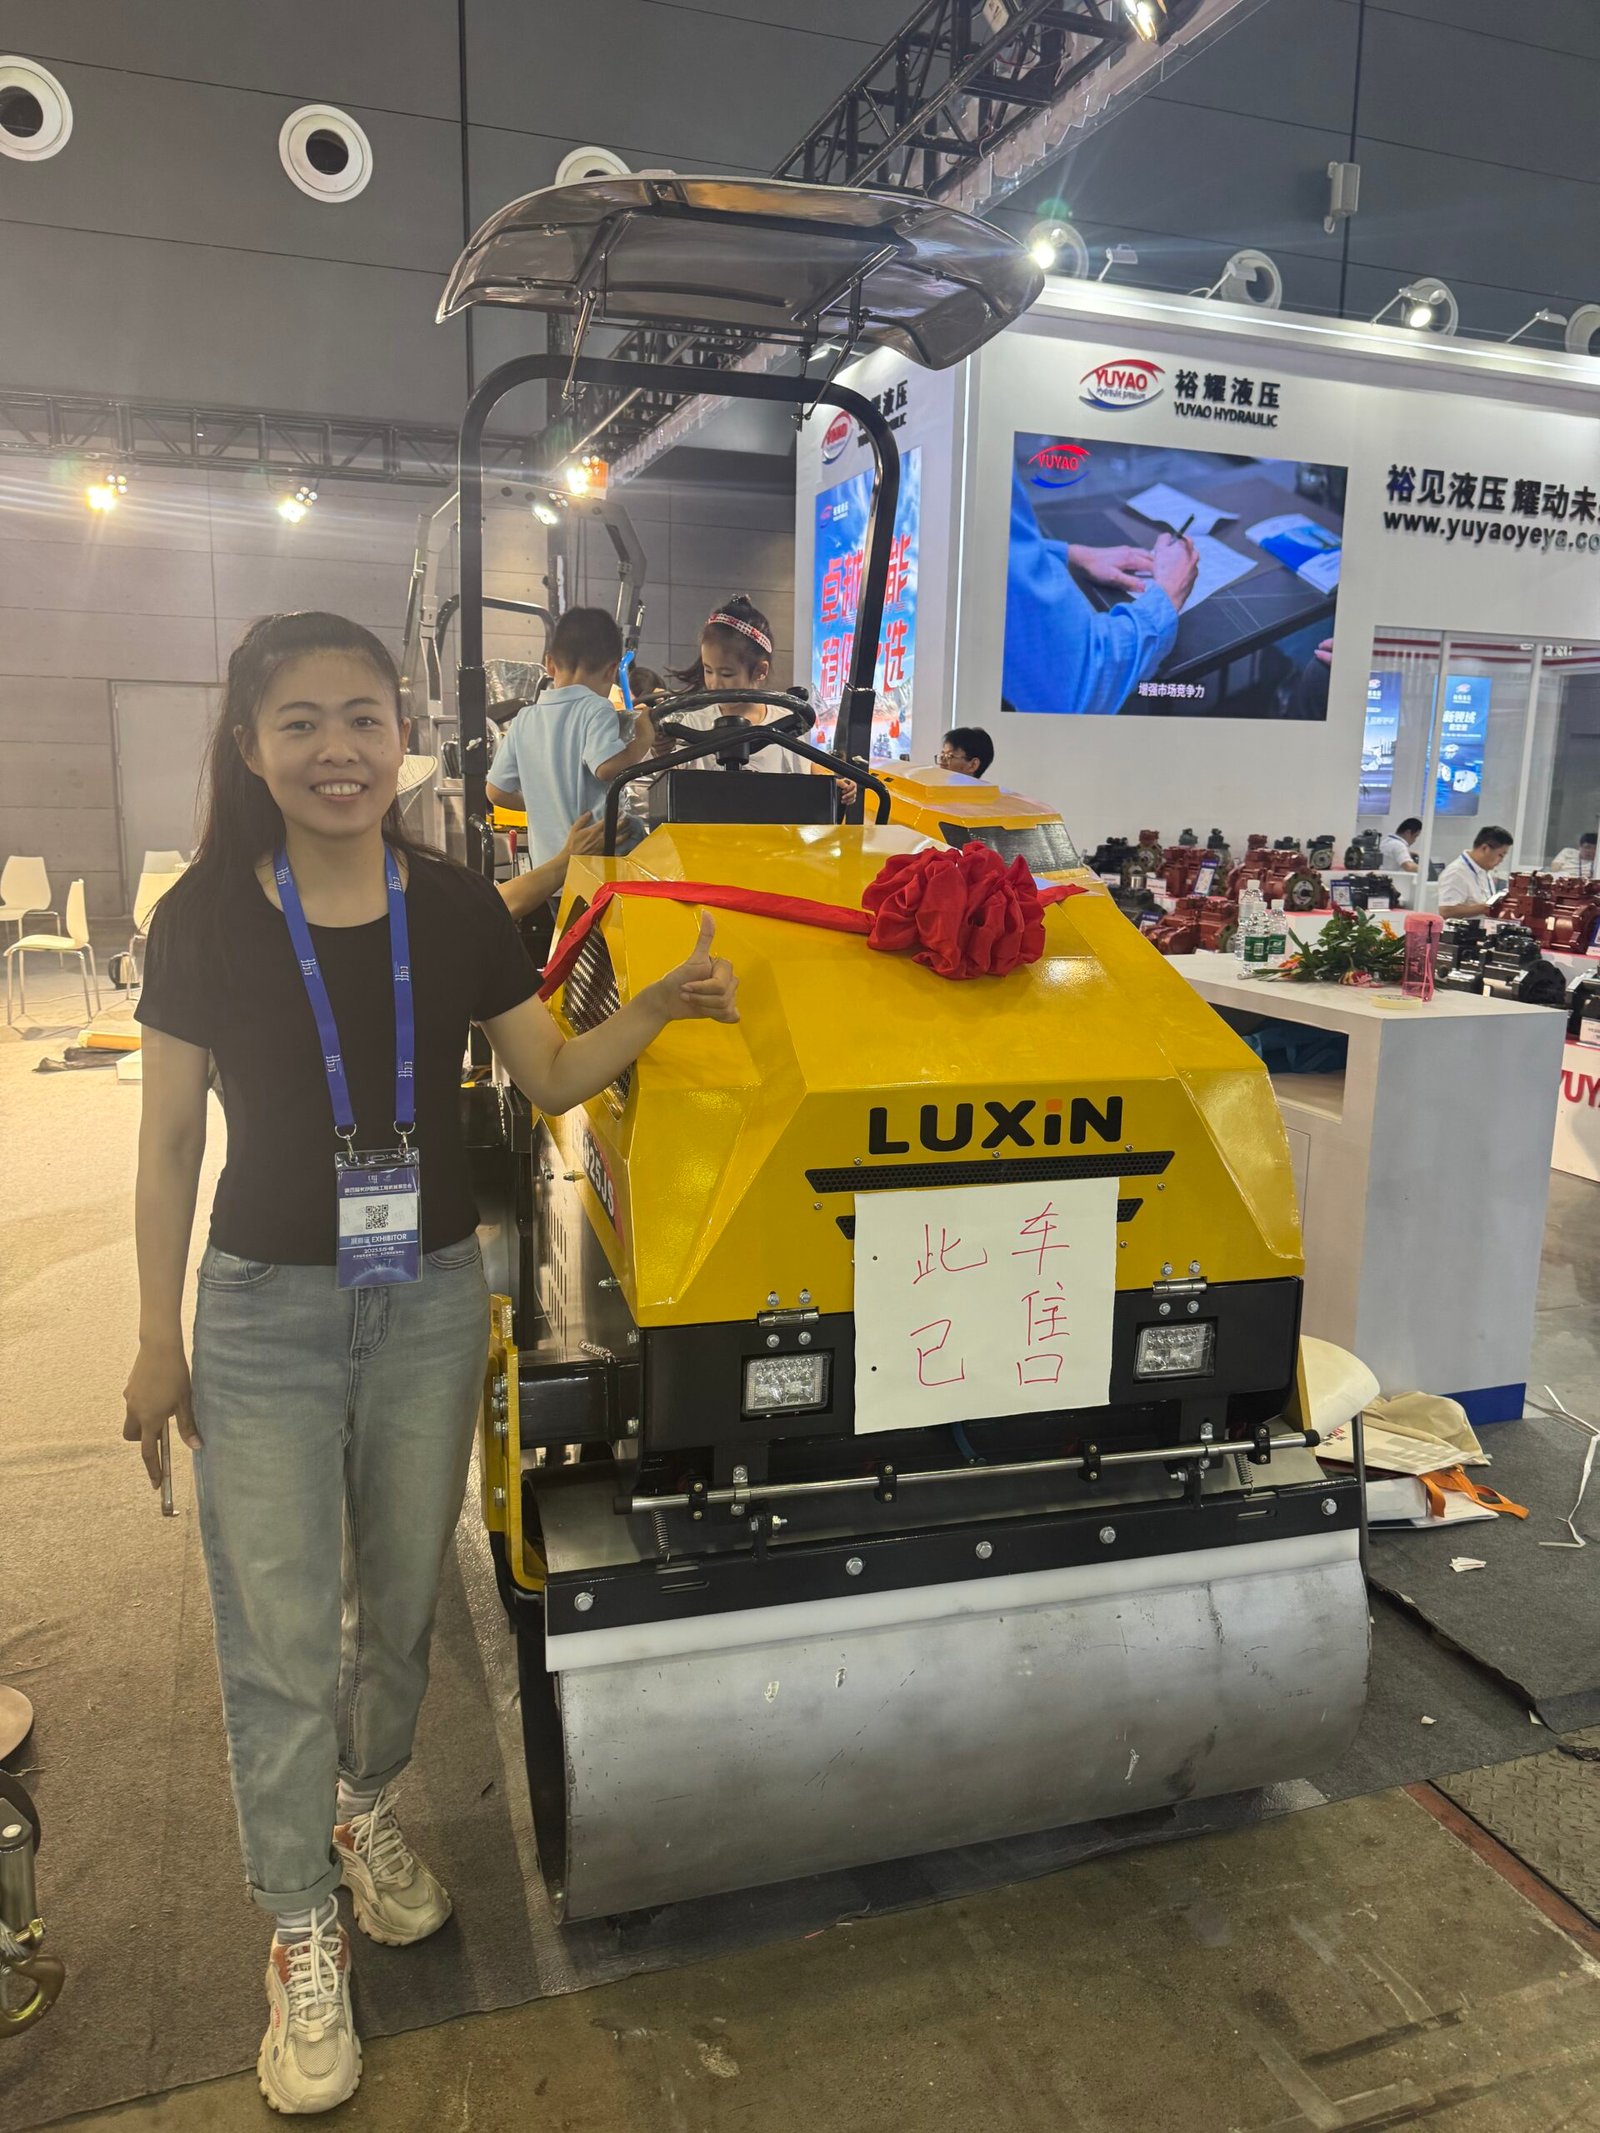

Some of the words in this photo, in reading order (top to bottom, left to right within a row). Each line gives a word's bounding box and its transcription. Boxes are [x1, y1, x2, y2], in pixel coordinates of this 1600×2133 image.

[1095, 369, 1148, 391] YUYAO
[1175, 369, 1280, 408] 裕耀液压
[1174, 402, 1212, 419] YUYAO
[1214, 405, 1278, 427] HYDRAULIC
[1038, 453, 1080, 471] YUYAO
[1386, 464, 1509, 511] 裕见液压
[1511, 479, 1600, 525] 耀动未
[821, 534, 911, 623] 卓越能
[1138, 682, 1205, 698] 增强市场竞争力
[1561, 1069, 1600, 1108] UY
[371, 1233, 407, 1243] EXHIBITOR
